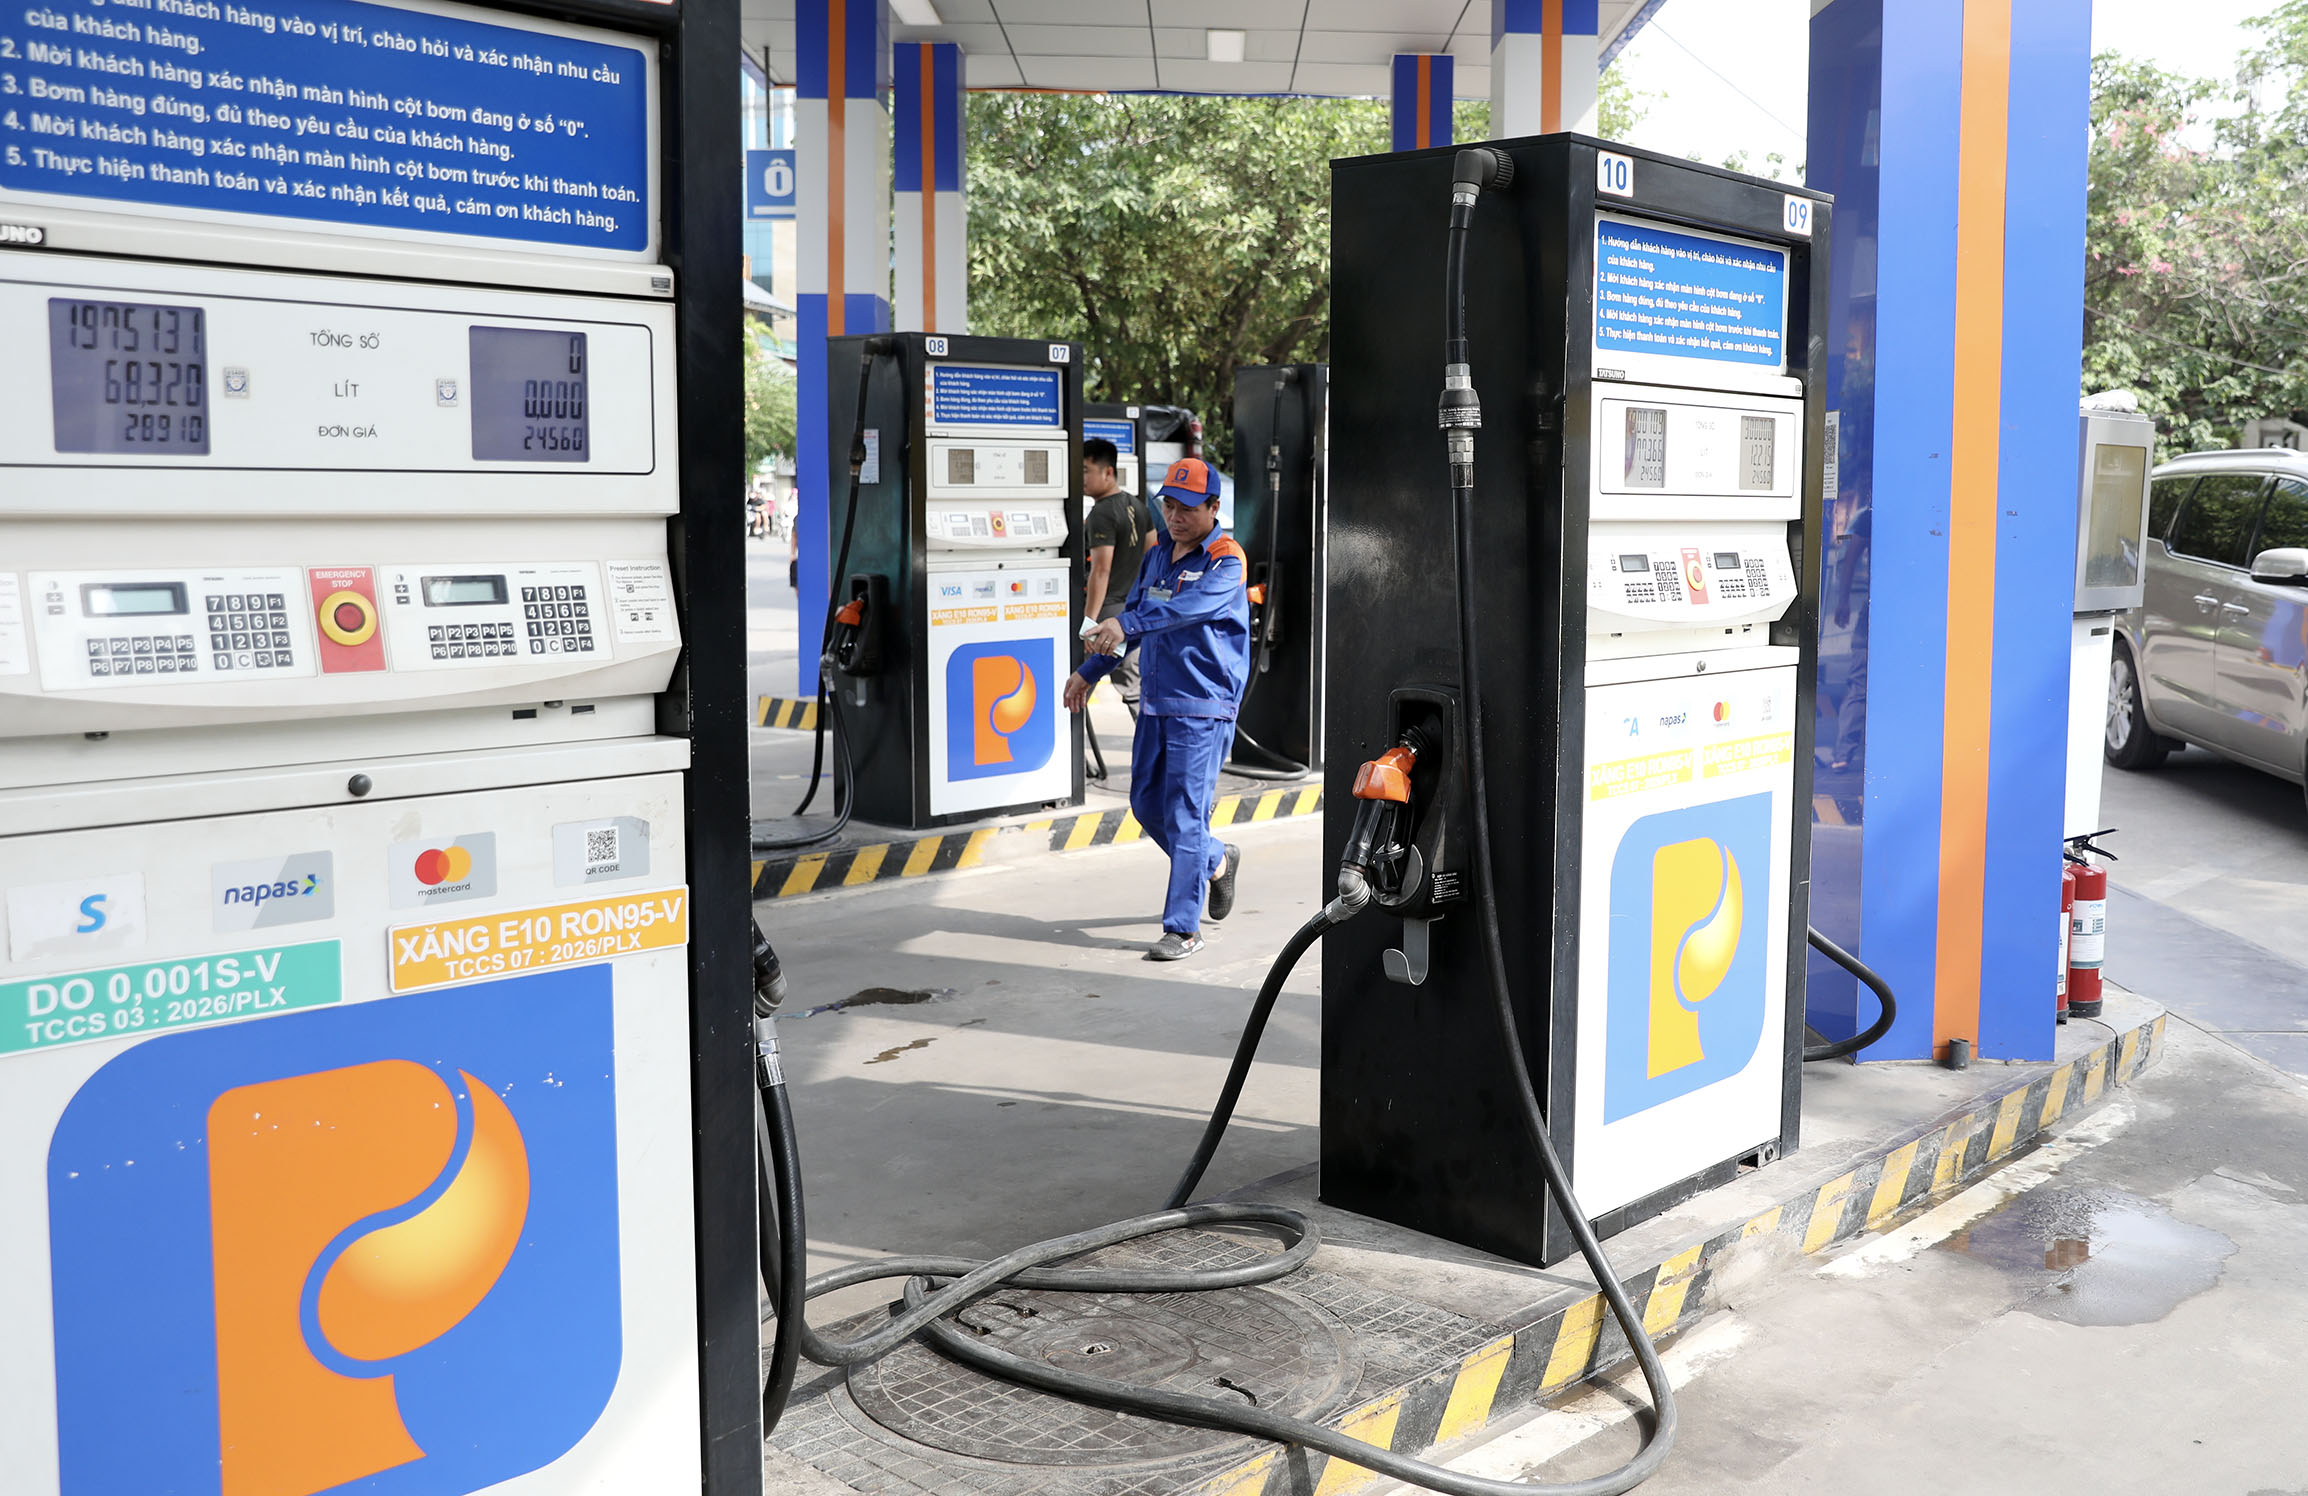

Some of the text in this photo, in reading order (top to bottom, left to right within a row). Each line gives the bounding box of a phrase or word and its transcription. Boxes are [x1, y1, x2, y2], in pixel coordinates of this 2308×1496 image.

[26, 9, 204, 54] của khách hàng.
[226, 5, 275, 33] hàng
[281, 16, 316, 35] vào
[321, 23, 337, 43] vị
[342, 26, 367, 47] trí,
[373, 32, 416, 52] chào
[422, 38, 448, 57] hỏi
[454, 45, 474, 61] và
[479, 49, 508, 66] xác
[512, 54, 552, 75] nhận
[558, 62, 587, 79] nhu
[592, 64, 619, 84] cầu
[2, 38, 21, 58] 2.
[28, 42, 72, 66] Mời
[78, 50, 144, 76] khách
[150, 60, 202, 89] hàng
[208, 72, 244, 90] xác
[249, 77, 297, 100] nhận
[303, 86, 343, 104] màn
[349, 90, 388, 110] hình
[394, 98, 422, 118] cột
[426, 101, 466, 121] bơm
[472, 108, 512, 132] đang
[518, 114, 530, 130] ở
[534, 114, 554, 133] số
[4, 74, 514, 161] 3. Bơm hàng đúng, đủ theo yêu cầu của khách hàng.
[4, 111, 639, 202] 4. Mời khách hàng xác nhận màn hình cột bơm trước khi thanh toán.
[7, 146, 26, 166] 5.
[33, 149, 92, 175] Thực
[98, 157, 144, 181] hiện
[150, 164, 209, 186] thanh
[214, 171, 258, 191] toán
[264, 177, 287, 194] và
[293, 180, 326, 198] xác
[331, 184, 376, 206] nhận
[382, 187, 409, 207] kết
[414, 194, 450, 214] quả,
[456, 198, 491, 216] cám
[523, 204, 571, 224] khách
[576, 210, 618, 232] hàng.
[1604, 158, 1807, 228] 10 09
[1602, 236, 1606, 245] 1.
[71, 303, 200, 354] 1975131
[360, 332, 380, 349] SỐ
[569, 336, 581, 374] 0
[929, 340, 1066, 360] 08 07
[334, 379, 359, 398] LÍT
[525, 380, 583, 421] 0,000
[125, 413, 202, 442] 28910
[318, 424, 378, 438] ĐƠN GIÁ
[524, 426, 582, 450] 24560
[315, 569, 367, 580] EMERGENCY
[331, 579, 354, 588] STOP
[525, 588, 583, 600] 7 8 9 F1
[941, 586, 962, 596] VISA
[529, 605, 586, 617] 4 5 6 F2
[531, 624, 538, 635] 1
[547, 623, 555, 634] 2
[564, 622, 571, 633] 3
[533, 640, 592, 652] 0 C F4
[1659, 715, 1681, 728] napas
[586, 864, 620, 875] QR CODE
[224, 880, 298, 906] napas
[418, 883, 470, 896] mastercard
[398, 897, 682, 965] XĂNG E10 RON95-V
[445, 954, 505, 978] TCCS
[510, 949, 534, 968] 07
[551, 932, 642, 962] 2026/PLX
[29, 952, 281, 1016] DO 0,001S-V
[27, 1013, 106, 1042] TCCS
[114, 1007, 144, 1028] 03
[168, 987, 286, 1021] 2026/PLX
